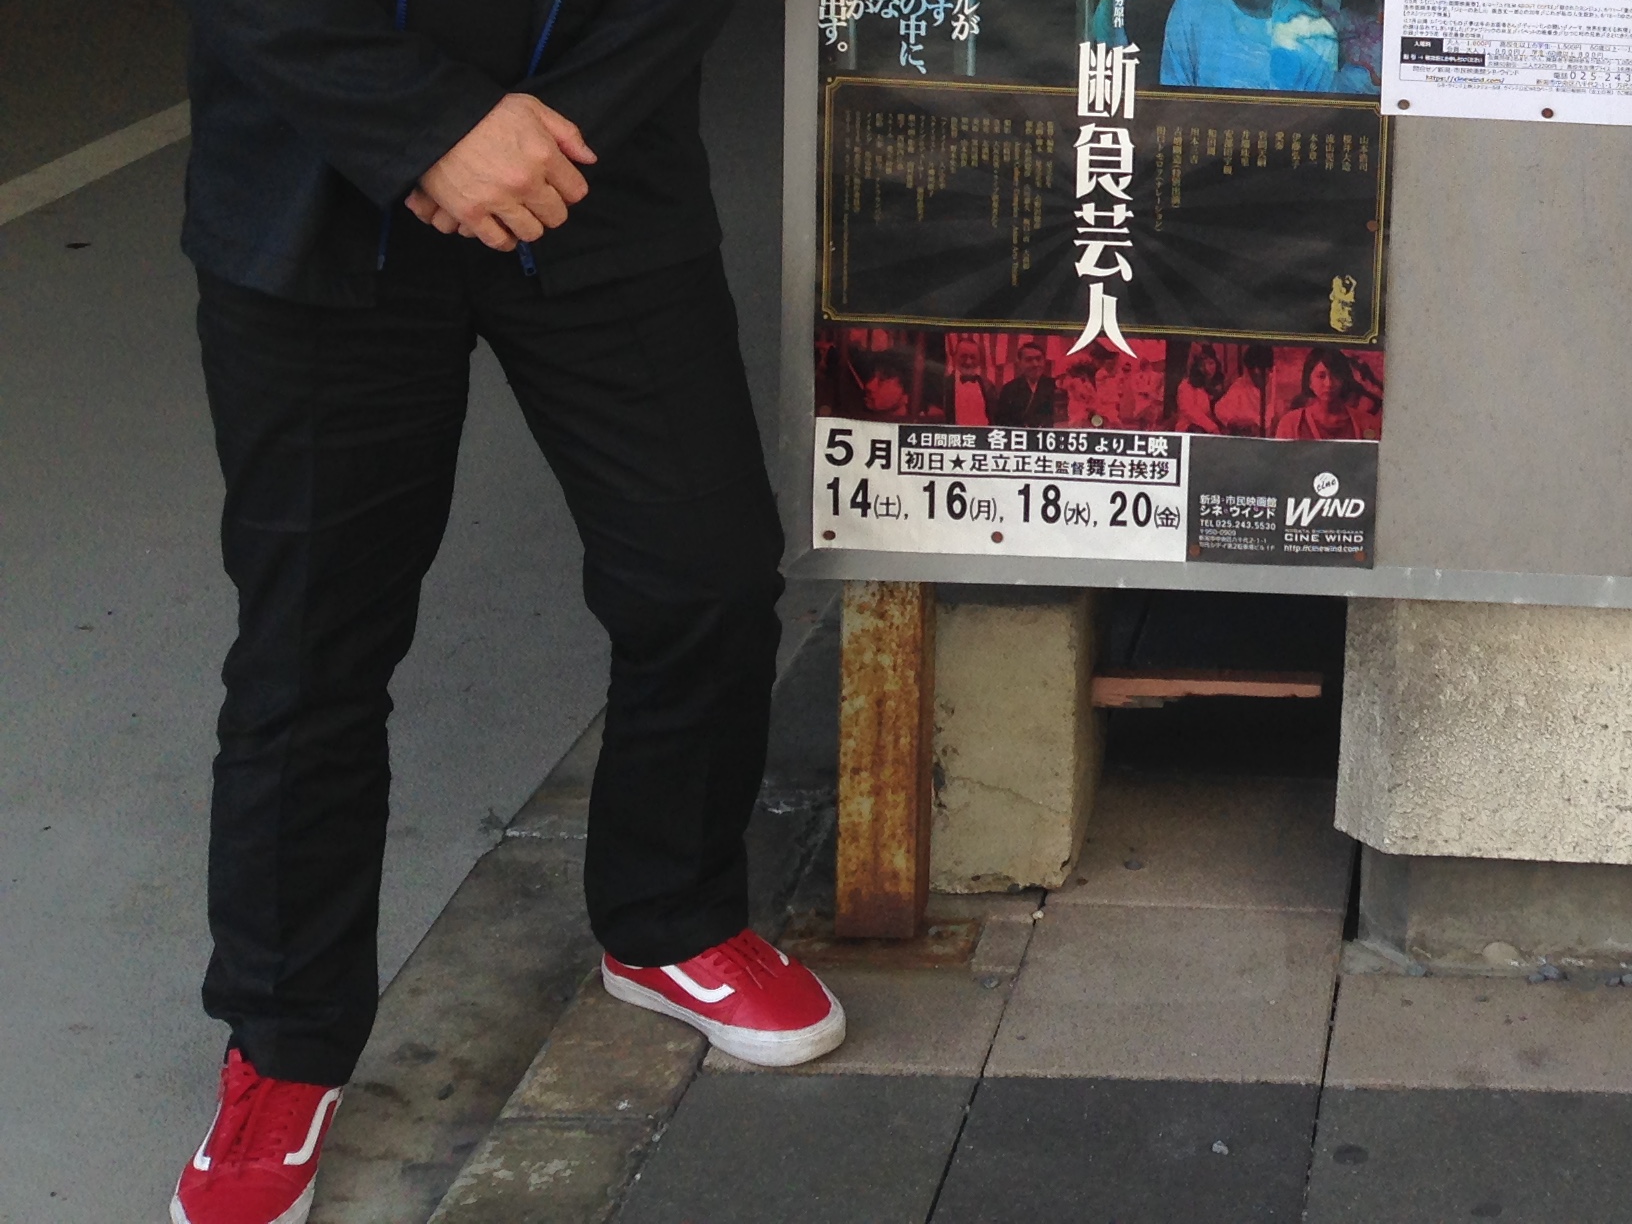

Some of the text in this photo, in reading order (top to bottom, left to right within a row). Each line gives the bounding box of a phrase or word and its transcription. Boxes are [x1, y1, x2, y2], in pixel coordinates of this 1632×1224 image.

[1066, 40, 1140, 359] 断食芸人
[823, 428, 893, 470] 5月
[907, 430, 1168, 457] 4日間限定 各日 16:55 より上映
[1199, 506, 1276, 519] シネ・ウインド
[1284, 533, 1364, 543] CINE WIND
